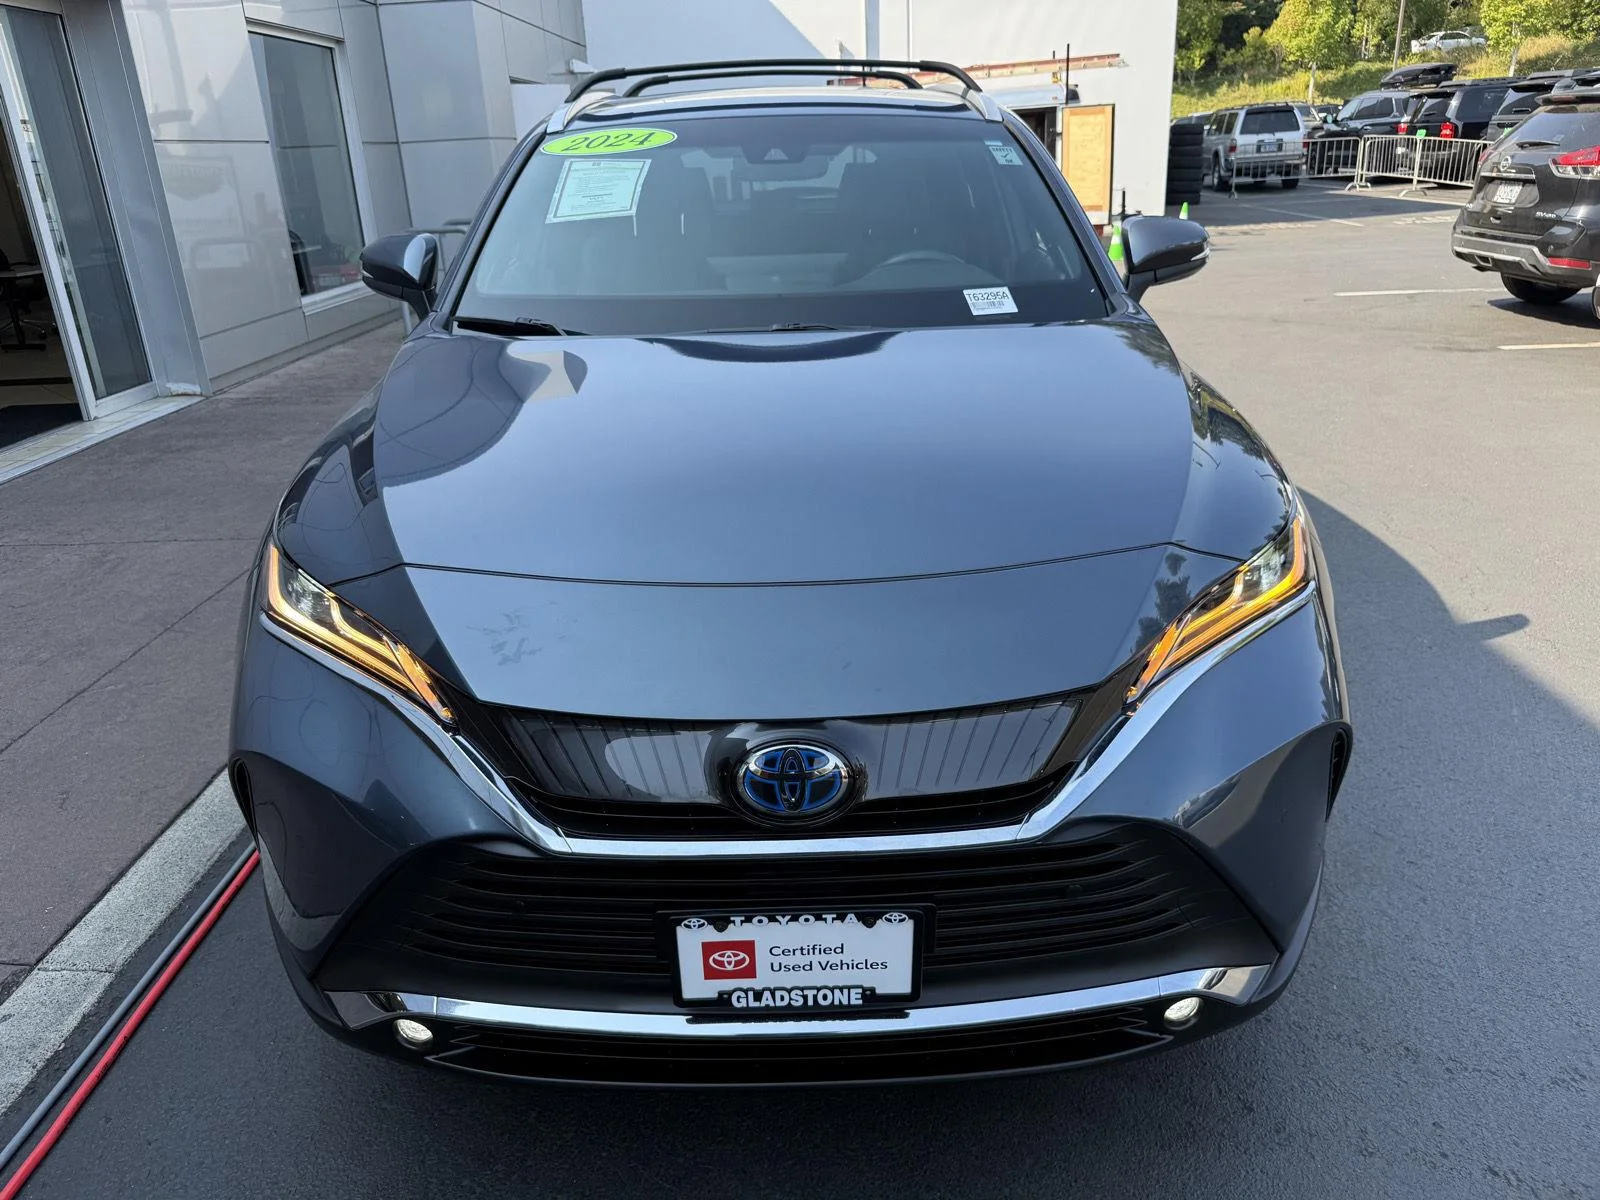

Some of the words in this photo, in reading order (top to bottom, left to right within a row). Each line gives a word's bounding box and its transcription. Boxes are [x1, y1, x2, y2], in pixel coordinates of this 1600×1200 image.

[561, 131, 656, 152] 2024
[966, 291, 1010, 302] T63295A
[730, 913, 861, 927] TOYOTA
[769, 943, 845, 957] Certified
[770, 961, 814, 972] Used
[817, 959, 889, 971] Vehicles
[731, 988, 863, 1008] GLADSTONE
